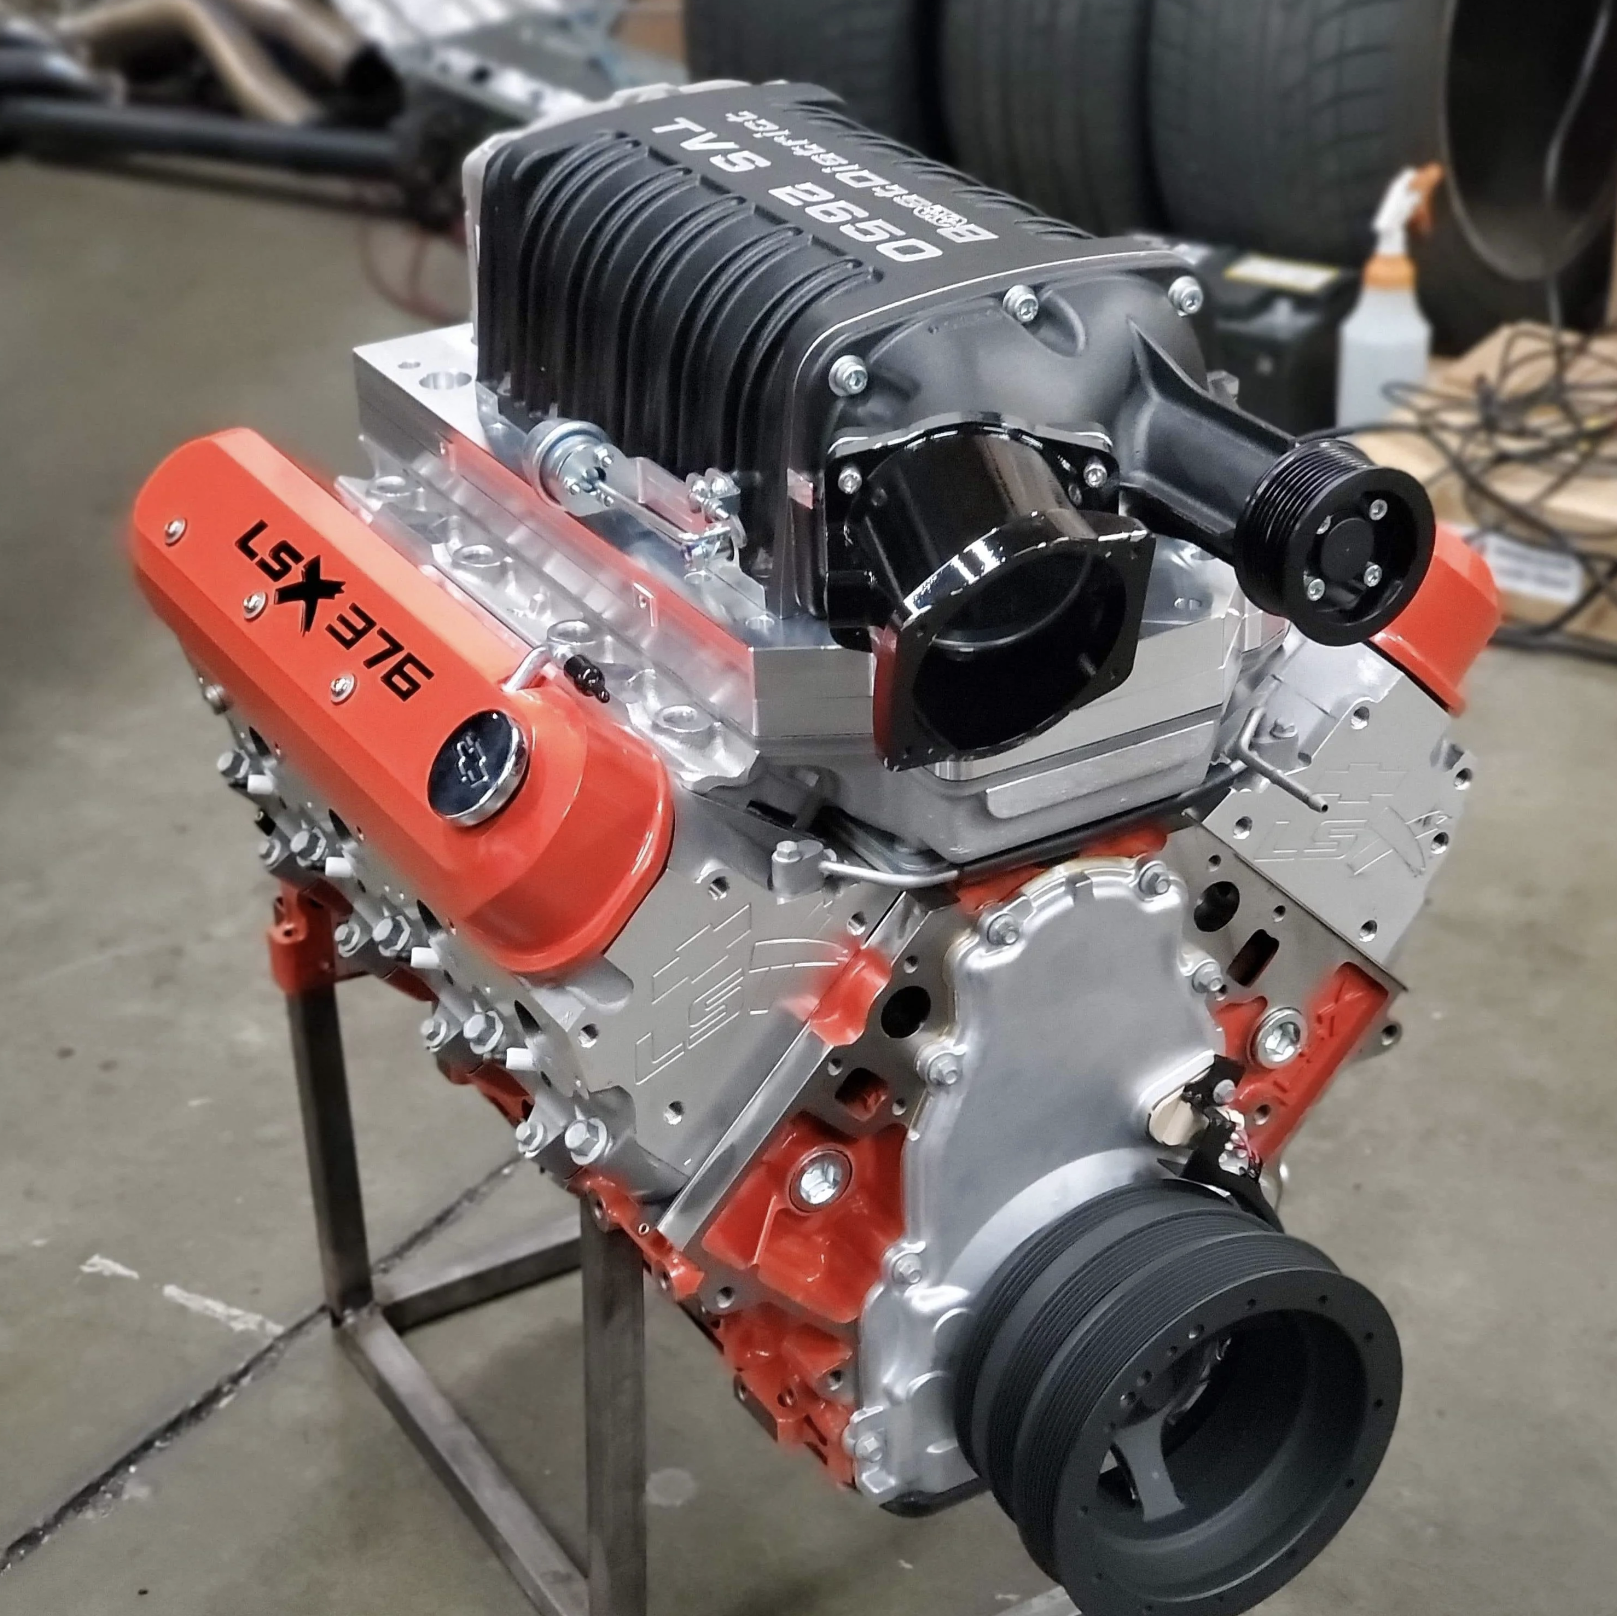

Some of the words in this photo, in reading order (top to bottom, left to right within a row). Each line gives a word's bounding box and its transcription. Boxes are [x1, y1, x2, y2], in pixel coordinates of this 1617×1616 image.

[651, 117, 772, 173] TVS
[768, 181, 943, 262] 2650
[234, 519, 346, 637] LSX
[325, 602, 434, 702] 376
